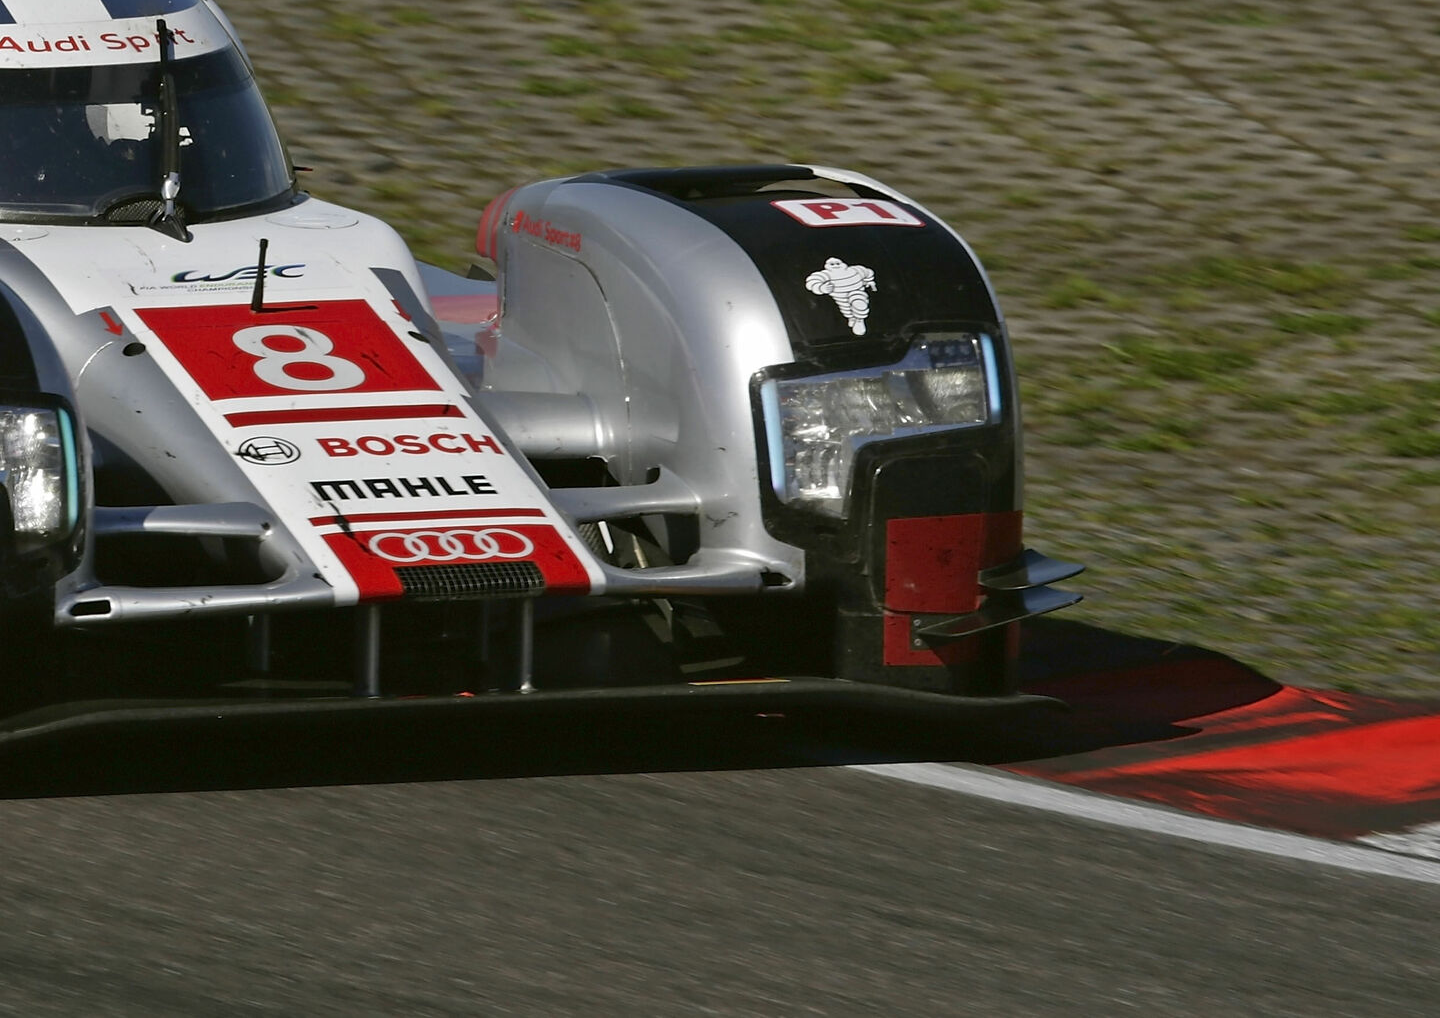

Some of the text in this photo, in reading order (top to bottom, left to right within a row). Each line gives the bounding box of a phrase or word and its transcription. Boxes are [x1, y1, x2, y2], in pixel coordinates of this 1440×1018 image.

[802, 202, 896, 220] P1
[171, 264, 306, 283] WEC
[232, 325, 366, 391] 8
[315, 432, 504, 458] BOSCH
[309, 474, 499, 501] MAHLE
